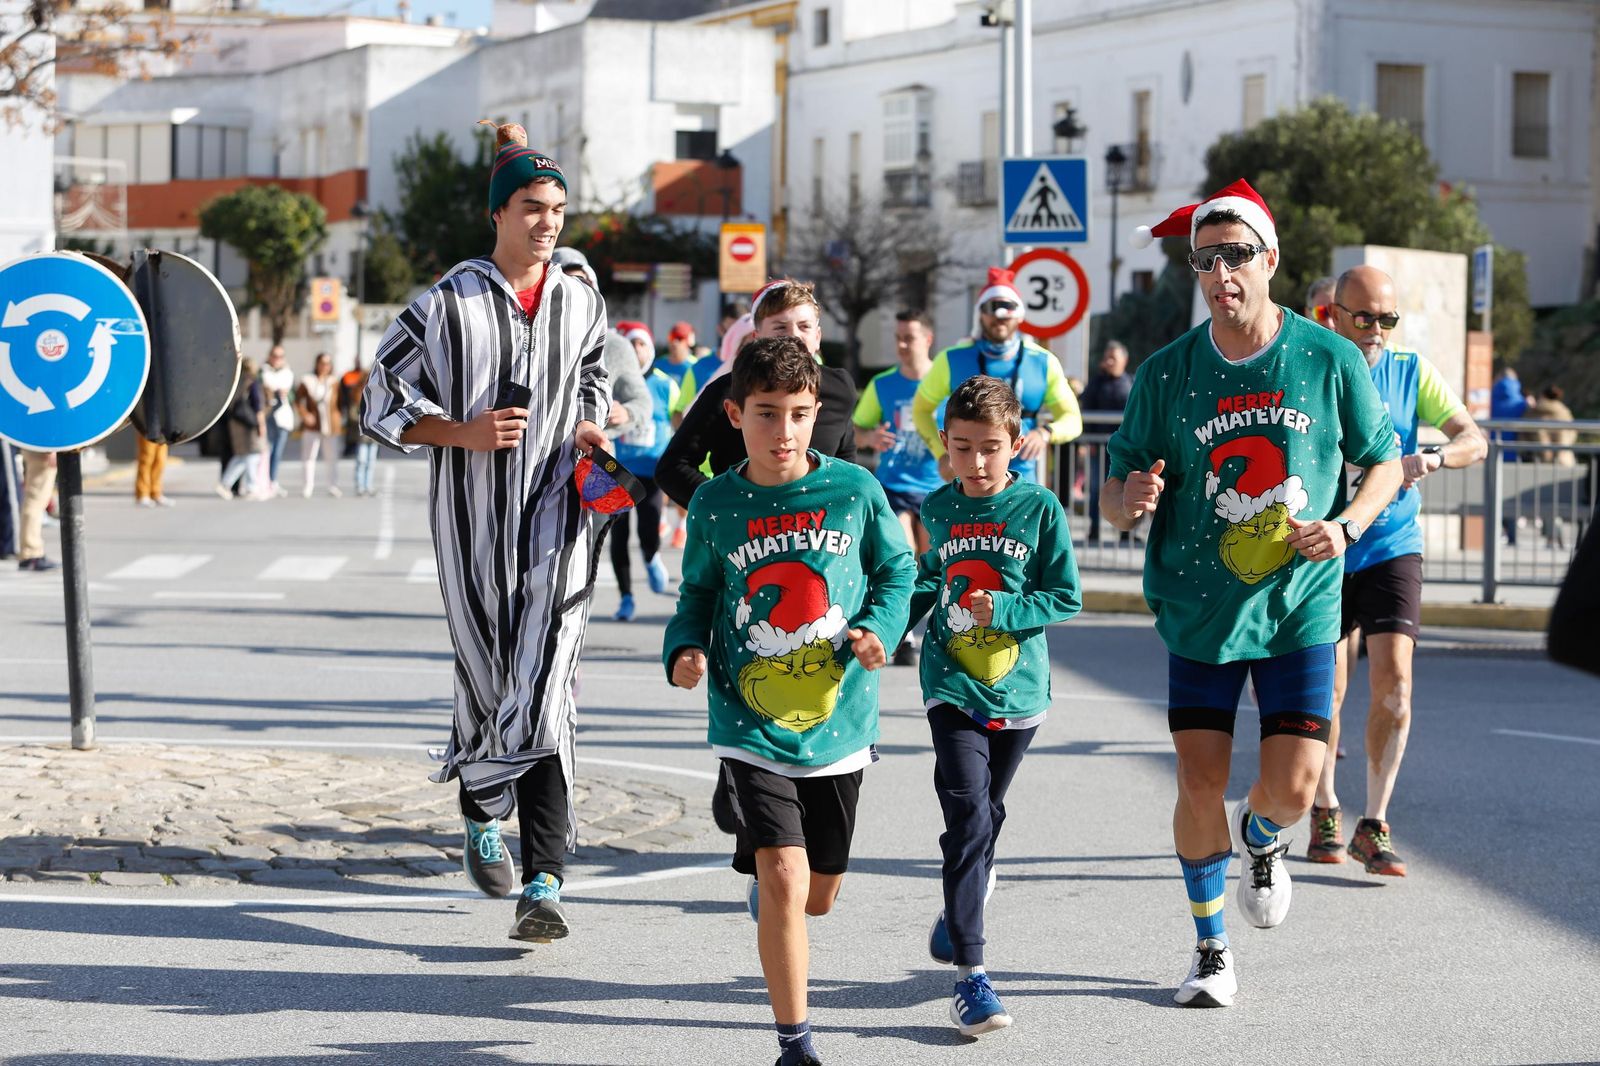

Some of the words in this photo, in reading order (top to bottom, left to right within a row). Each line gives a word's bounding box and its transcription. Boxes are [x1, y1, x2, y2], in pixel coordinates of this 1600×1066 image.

[1217, 389, 1284, 414] MERRY
[1194, 405, 1311, 445] WHATEVER
[747, 508, 826, 539] MERRY
[950, 522, 1006, 539] MERRY
[727, 527, 852, 571] WHATEVER
[938, 535, 1028, 563] WHATEVER
